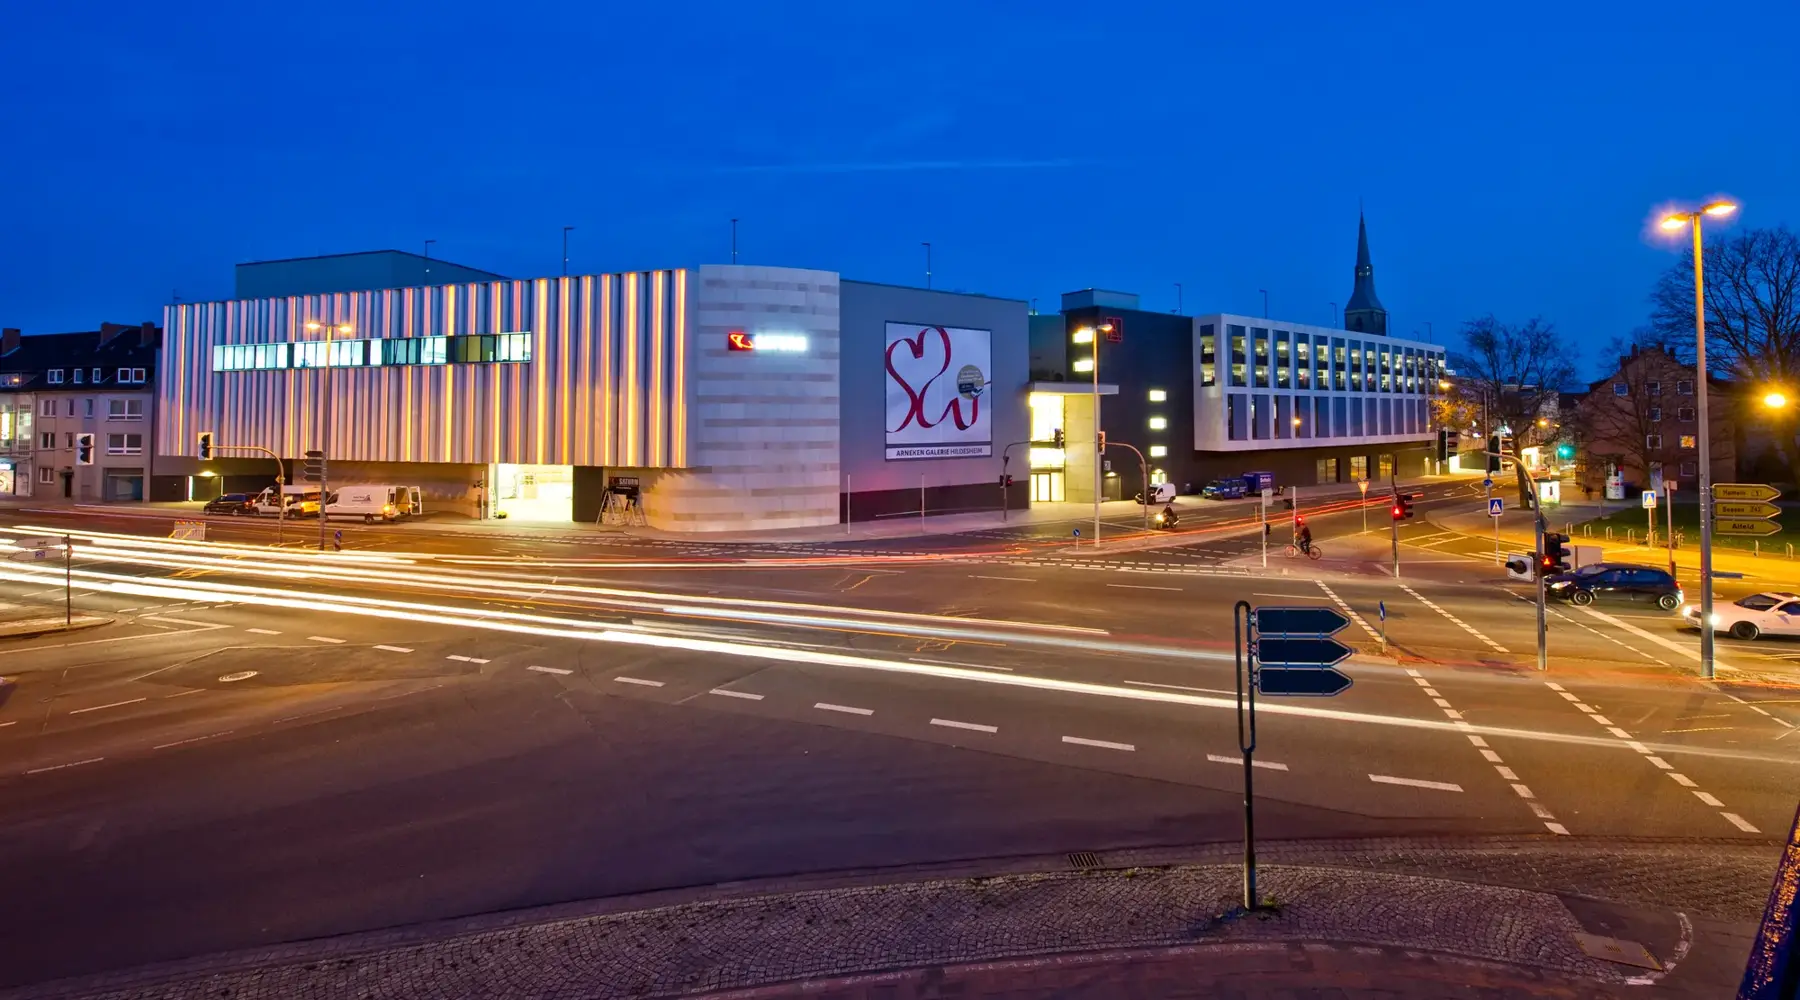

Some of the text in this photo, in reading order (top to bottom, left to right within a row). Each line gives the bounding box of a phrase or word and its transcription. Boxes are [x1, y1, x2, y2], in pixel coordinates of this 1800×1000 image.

[896, 447, 983, 457] ARNEKEN GALERIE HILDESHEIM
